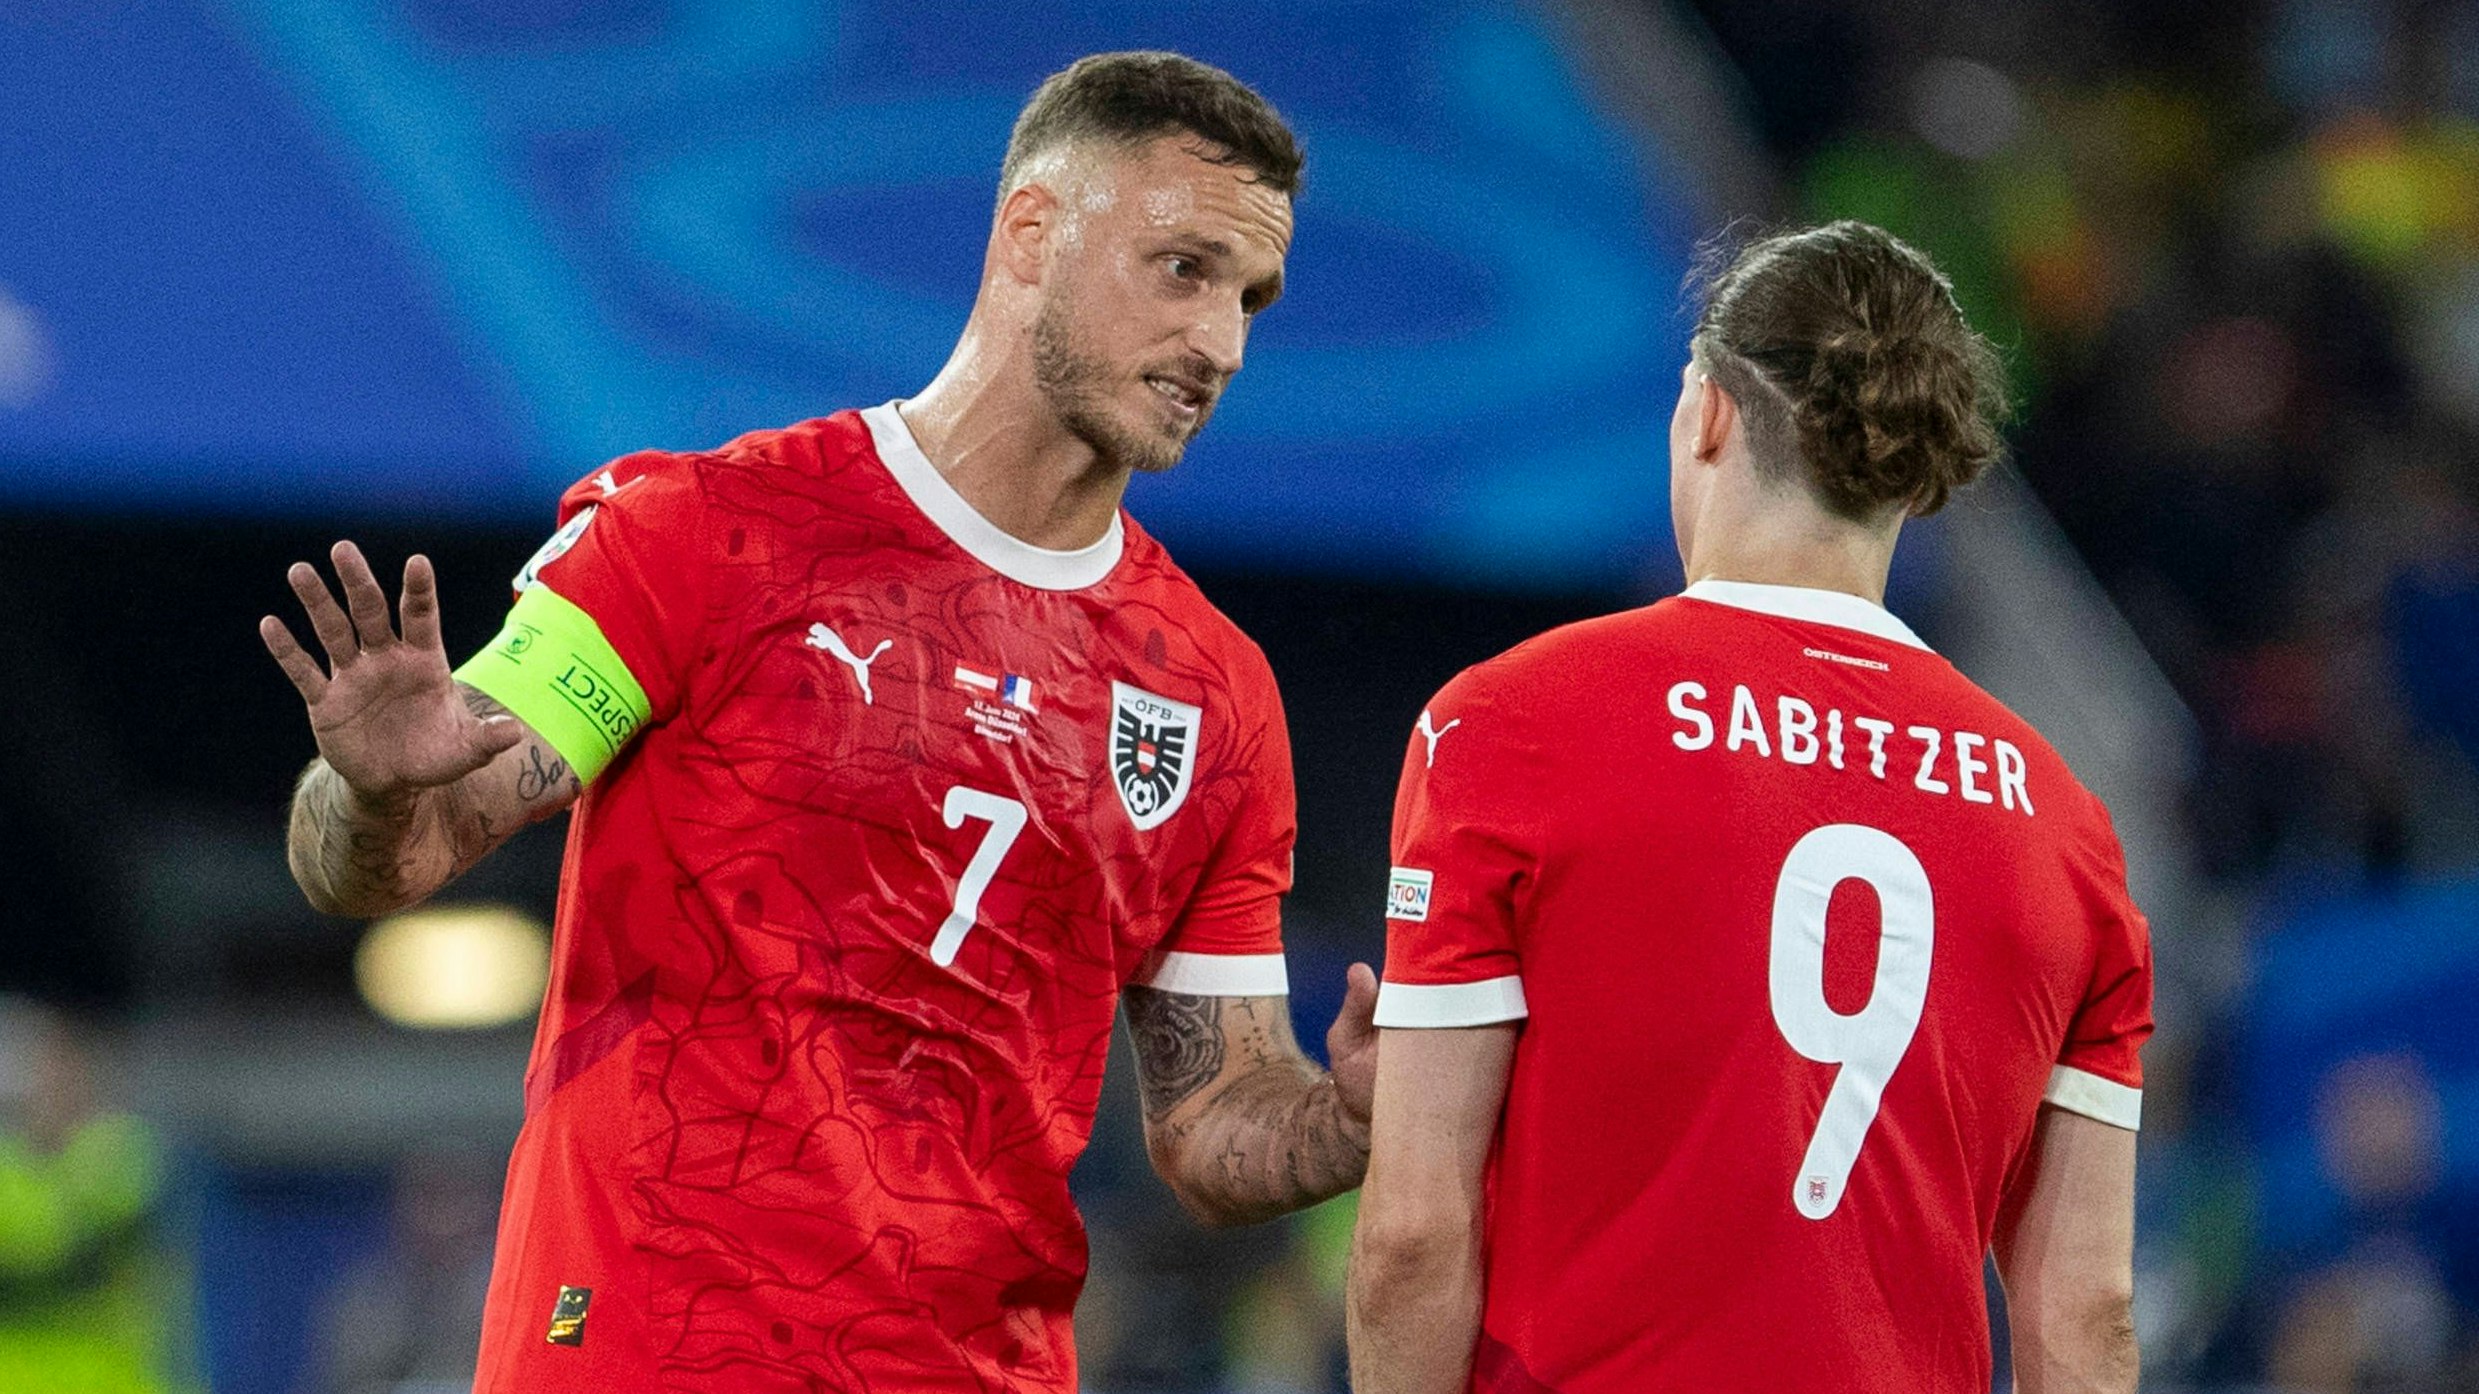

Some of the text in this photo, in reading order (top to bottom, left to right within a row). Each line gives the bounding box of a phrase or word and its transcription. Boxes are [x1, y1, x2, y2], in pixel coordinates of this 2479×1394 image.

[1667, 681, 2034, 816] SABITZER
[929, 785, 1028, 967] 7
[1769, 823, 1934, 1220] 9
